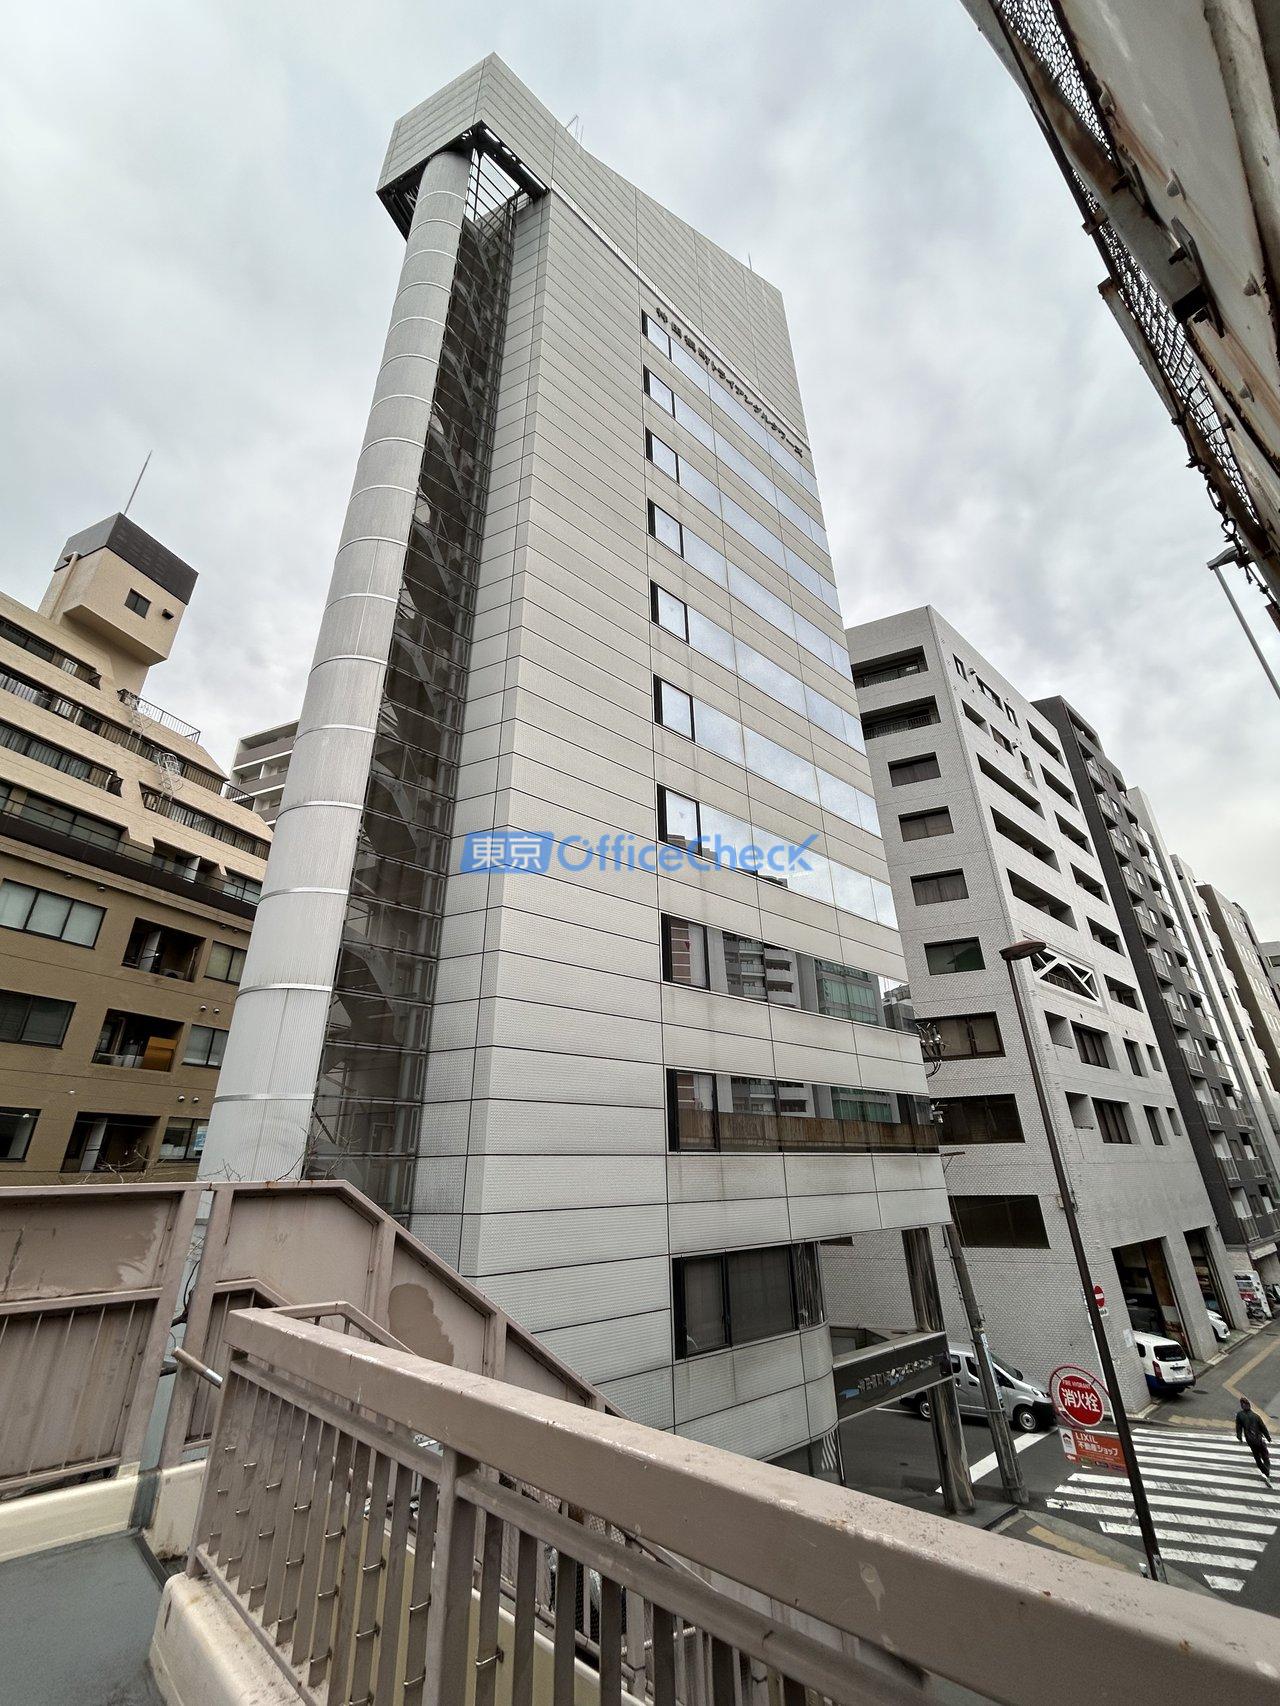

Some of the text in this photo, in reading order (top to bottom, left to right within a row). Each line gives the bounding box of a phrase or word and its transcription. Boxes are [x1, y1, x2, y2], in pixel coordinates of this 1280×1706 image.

[1061, 1387, 1101, 1413] 消火栓
[1074, 1432, 1099, 1444] LIXIL
